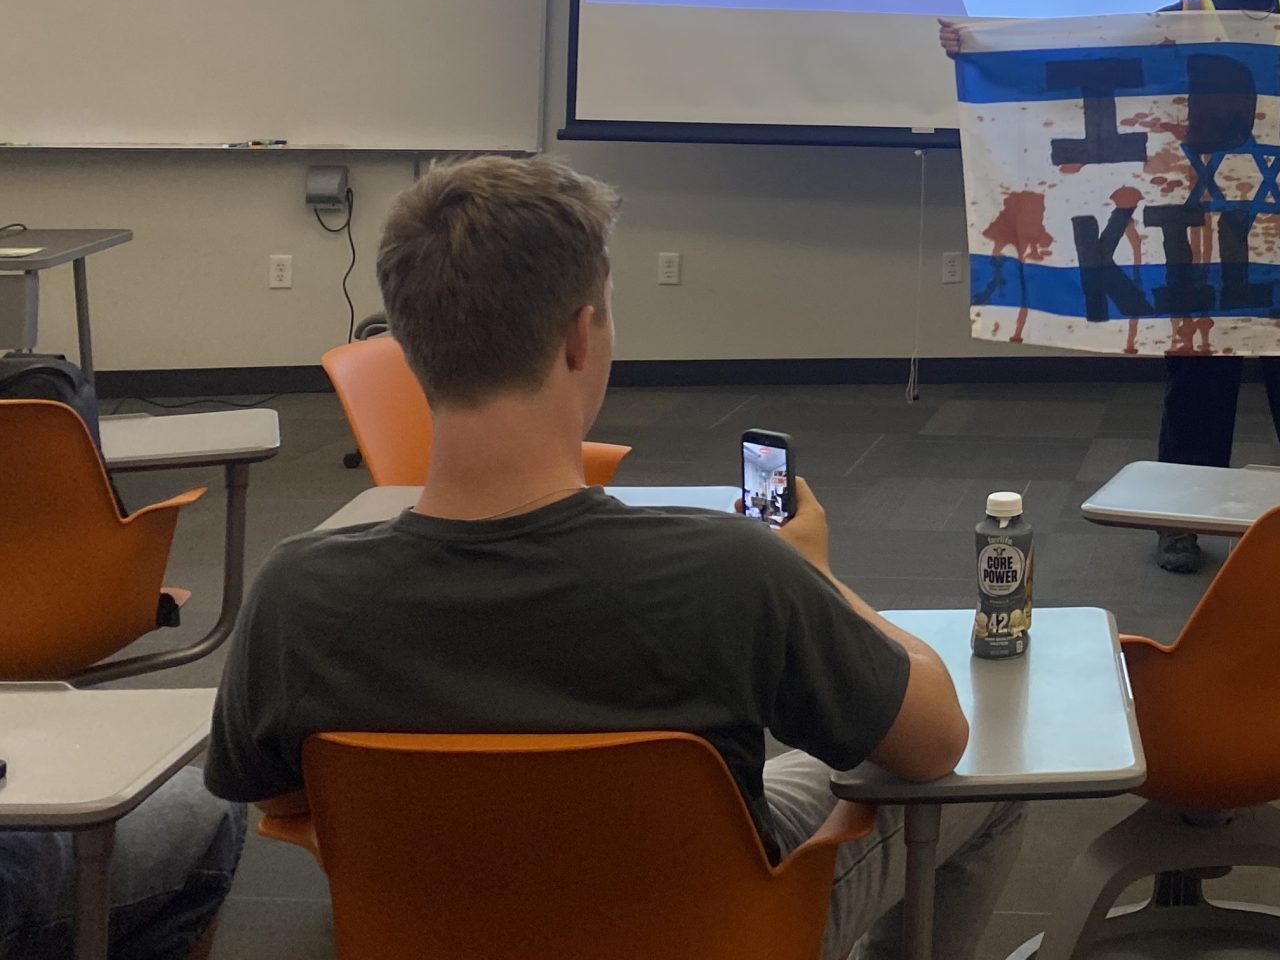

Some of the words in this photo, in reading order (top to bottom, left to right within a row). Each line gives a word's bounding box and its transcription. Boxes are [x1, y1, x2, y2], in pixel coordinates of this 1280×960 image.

[987, 556, 1013, 570] CORE
[983, 569, 1018, 584] POWER
[988, 613, 1008, 633] 42
